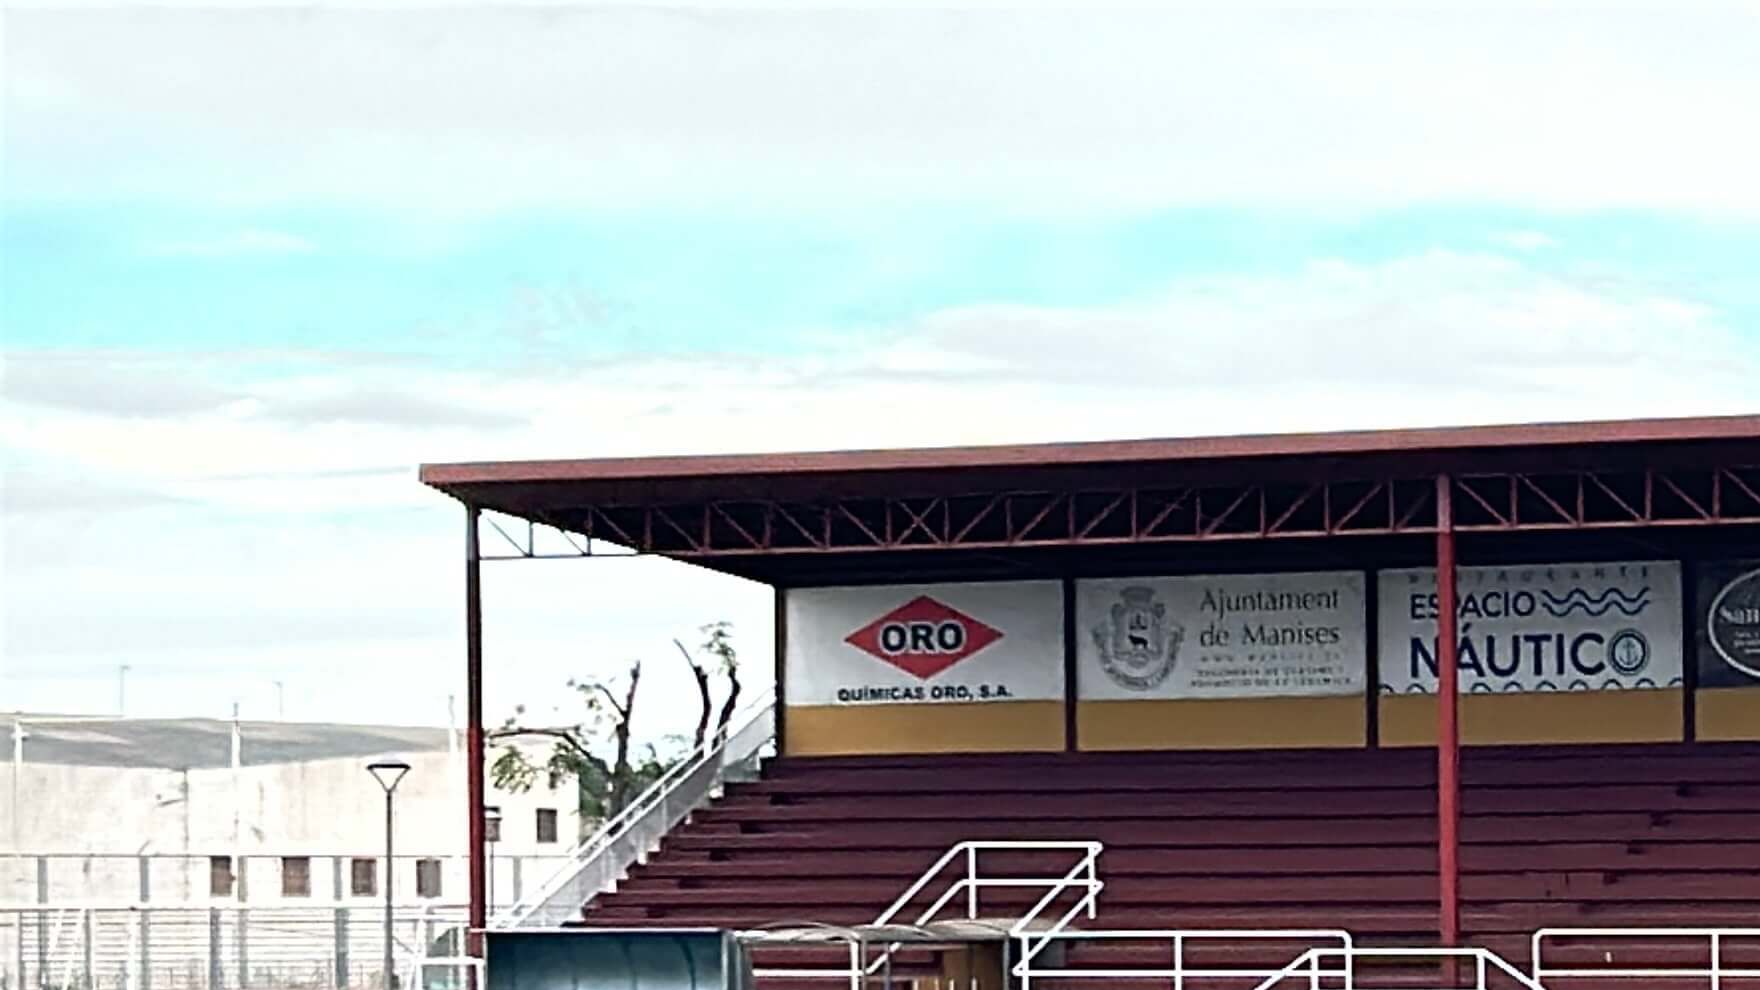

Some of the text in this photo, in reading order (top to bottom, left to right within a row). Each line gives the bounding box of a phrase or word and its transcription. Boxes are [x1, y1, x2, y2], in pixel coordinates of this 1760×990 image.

[1200, 588, 1338, 619] Ajuntament
[1410, 590, 1536, 619] ESACIO
[1719, 605, 1760, 624] San
[881, 622, 963, 652] ORO
[1200, 620, 1341, 646] de Manises
[1410, 622, 1648, 678] NÁUTICO
[980, 684, 1013, 698] S.A.
